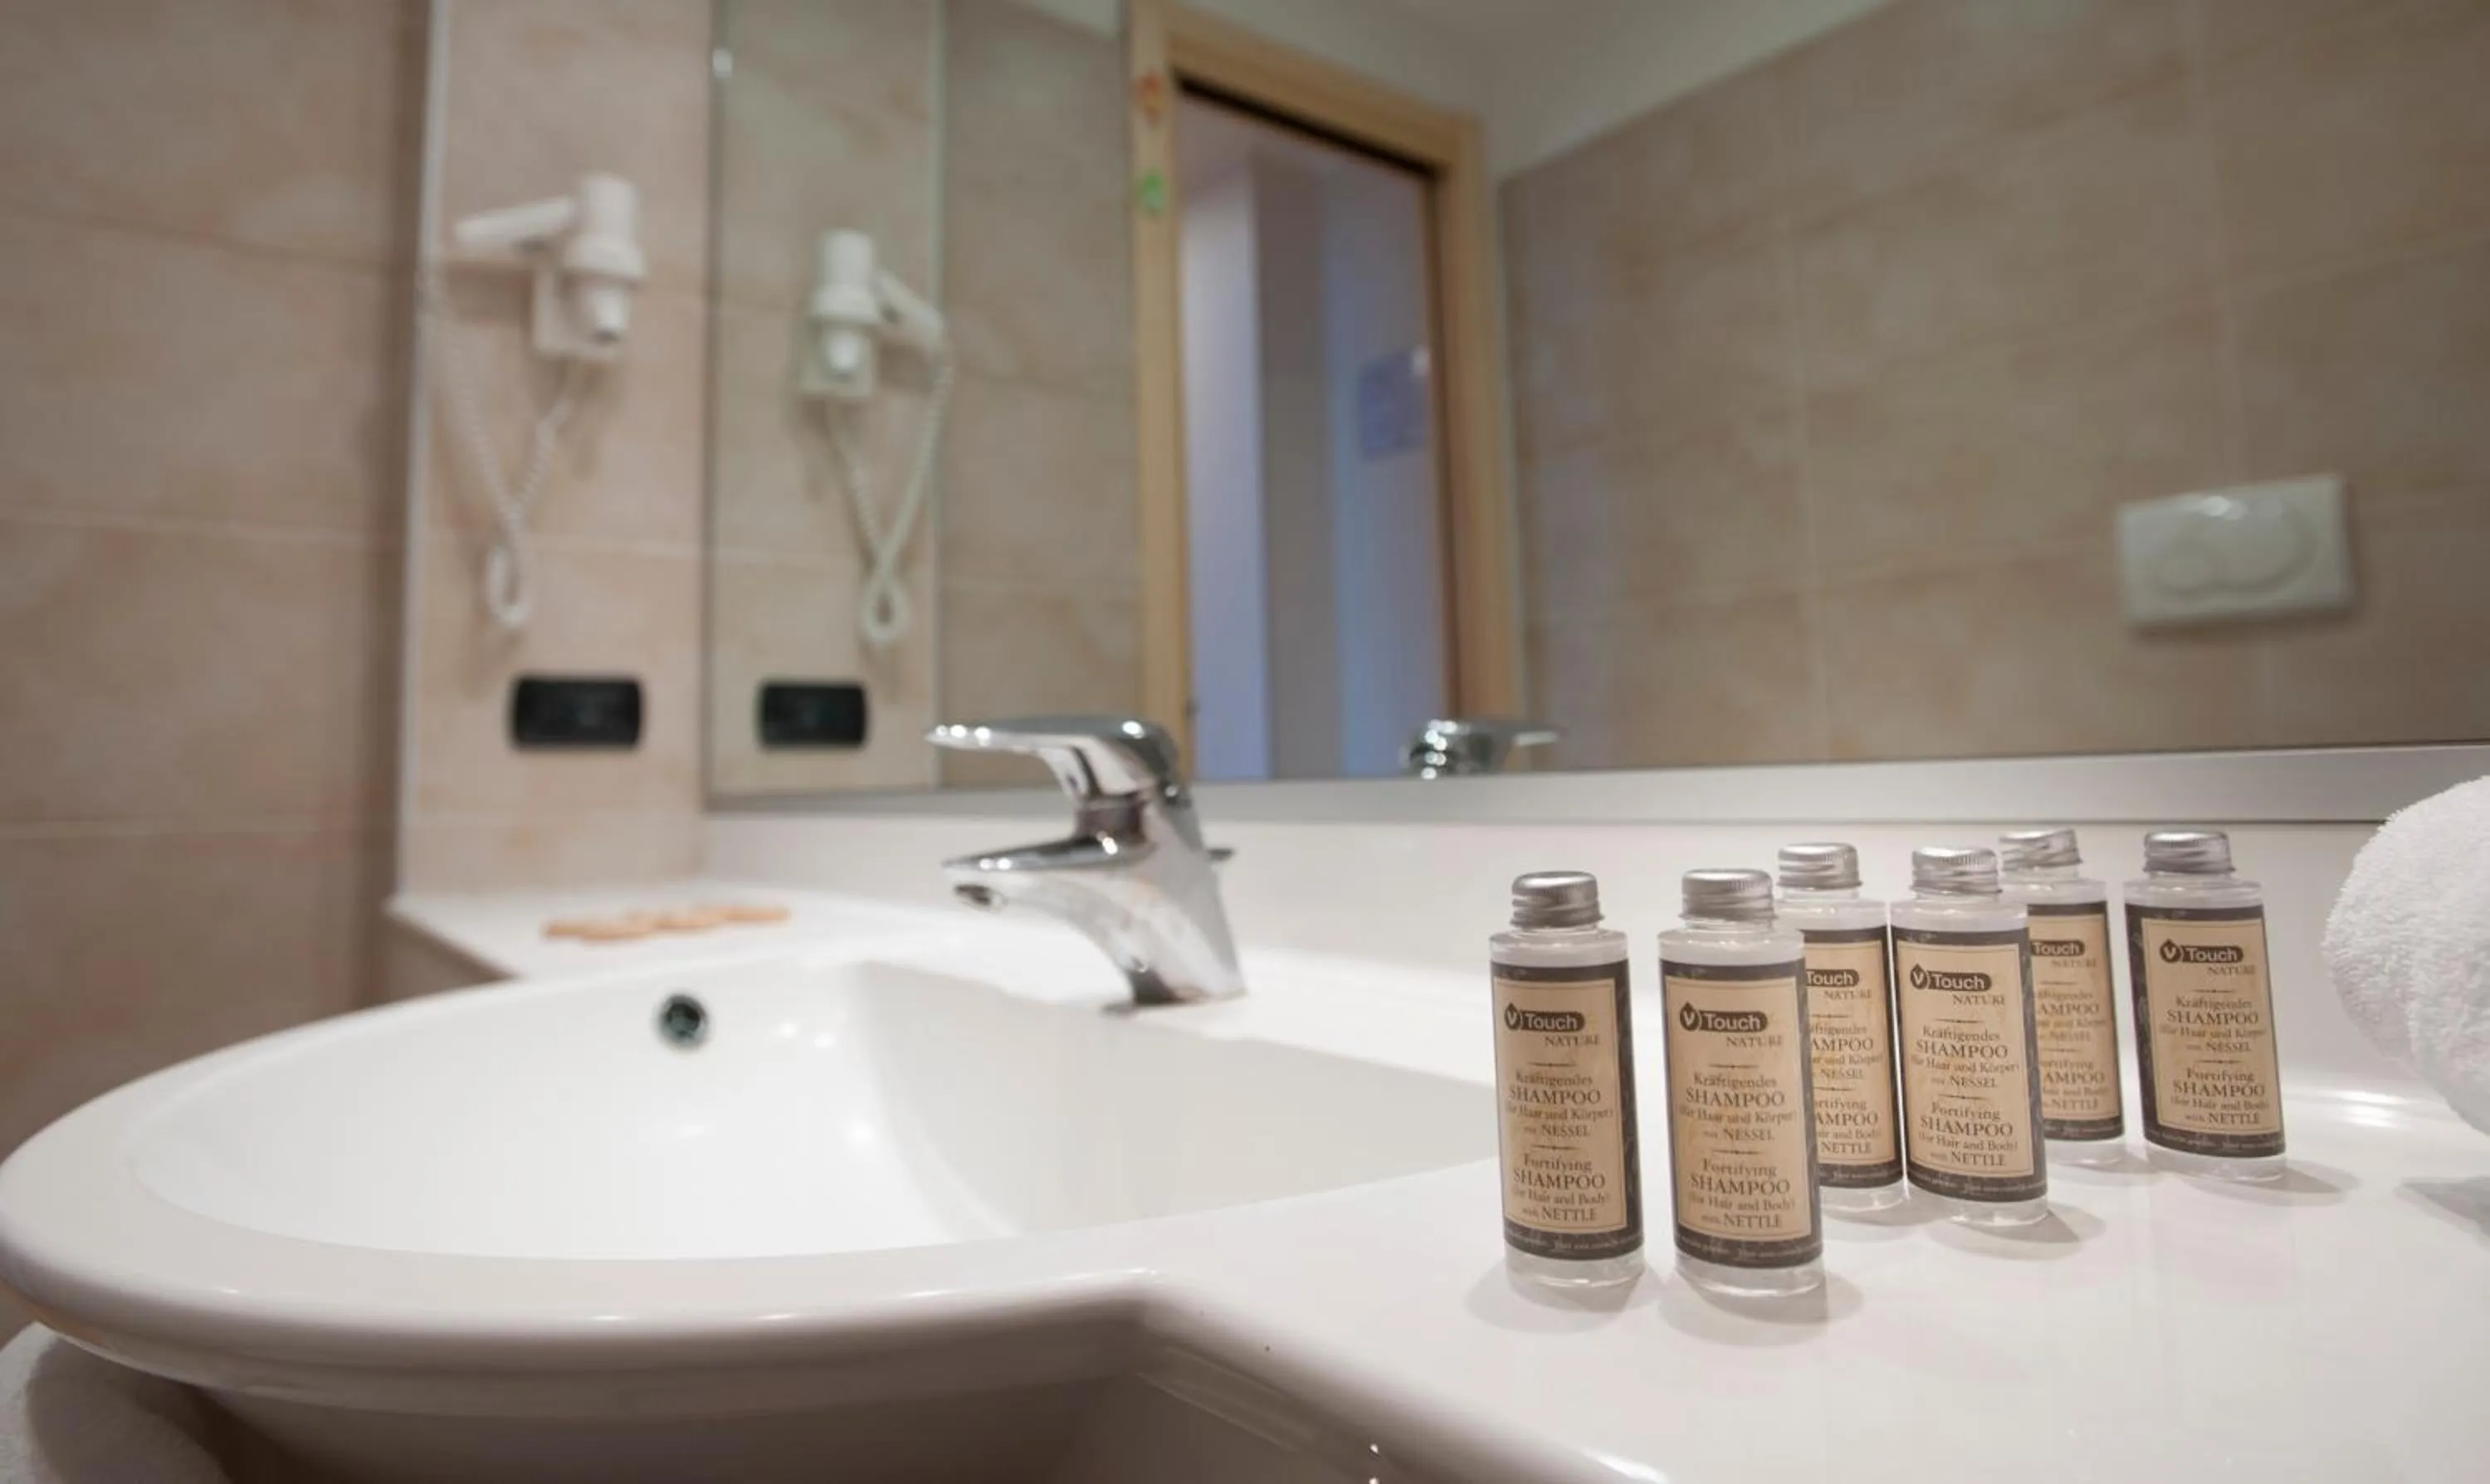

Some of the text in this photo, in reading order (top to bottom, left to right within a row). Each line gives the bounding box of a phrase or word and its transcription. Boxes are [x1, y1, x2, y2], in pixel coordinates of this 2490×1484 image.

[2034, 942, 2080, 954] Touch
[2185, 947, 2238, 961] Touch
[1806, 971, 1854, 986] Touch
[1931, 974, 1985, 990] Touch
[1952, 994, 2006, 1006] NATURE
[2039, 1002, 2100, 1015] AMPOO
[1526, 1013, 1577, 1030] Touch
[1704, 1013, 1760, 1030] Touch
[2165, 1008, 2259, 1025] SHAMPOO
[1812, 1037, 1874, 1052] AMPOO
[1916, 1039, 2009, 1058] SHAMPOO
[2205, 1042, 2252, 1053] NESSEL
[1950, 1075, 1997, 1088] NESSEL
[2044, 1072, 2106, 1084] AMPOO
[2186, 1067, 2256, 1083] Fortifying
[1509, 1086, 1601, 1105] SHAMPOO
[2173, 1080, 2266, 1097] SHAMPOO
[1686, 1086, 1785, 1108] SHAMPOO
[1931, 1101, 2001, 1120] Fortifying
[1815, 1112, 1879, 1126] AMPOO
[1920, 1115, 2014, 1136] SHAMPOO
[2207, 1112, 2260, 1125] NETTLE
[1540, 1124, 1591, 1137] NESSEL
[1723, 1127, 1775, 1141] NESSEL
[1820, 1141, 1872, 1154] NETTLE
[1936, 1135, 1960, 1149] Hair
[1963, 1140, 1984, 1151] and
[1523, 1153, 1594, 1174] Fortifying
[1951, 1151, 2006, 1166] NETTLE
[1702, 1158, 1778, 1179] Fortifying
[1513, 1168, 1606, 1190] SHAMPOO
[1689, 1173, 1790, 1196] SHAMPOO
[1554, 1192, 1575, 1204] and
[1541, 1206, 1597, 1222] NETTLE
[1723, 1213, 1783, 1228] NETTLE
